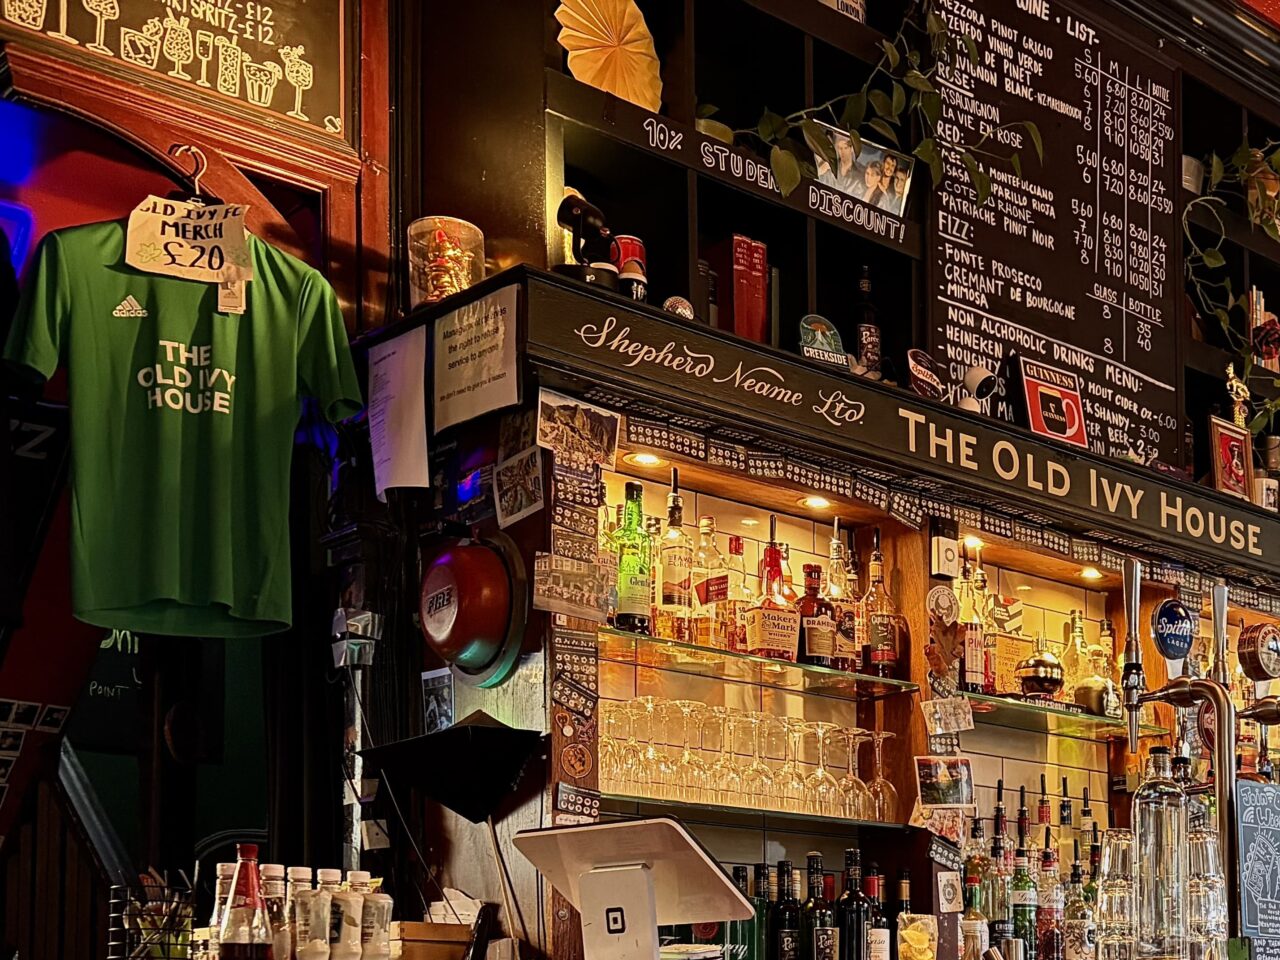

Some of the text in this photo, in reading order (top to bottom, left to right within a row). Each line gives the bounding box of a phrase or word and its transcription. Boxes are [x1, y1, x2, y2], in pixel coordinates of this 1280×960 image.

[1016, 0, 1050, 21] WINE
[991, 19, 1019, 43] PINOT
[1022, 36, 1053, 60] GRIGIO
[985, 51, 1032, 86] DE PINET
[987, 34, 1014, 59] VINHO
[1018, 51, 1043, 77] VERDE
[1084, 48, 1170, 103] S M L BOTTLE
[1083, 85, 1091, 98] 6
[1153, 103, 1167, 121] 24
[937, 120, 965, 144] RED:
[942, 105, 1023, 149] LA VIE EN ROSE
[1083, 100, 1092, 115] 7
[1152, 136, 1164, 155] 29
[1083, 116, 1092, 131] 8
[1152, 152, 1164, 167] 31
[644, 118, 906, 244] 10% STUDEN DISCOUNT!
[1083, 167, 1091, 183] 6
[1152, 180, 1166, 194] 24
[942, 161, 1056, 220] ISASA RIOJA
[944, 181, 1034, 224] COTE RHONE
[180, 207, 218, 220] IVY
[223, 206, 241, 219] FC
[938, 210, 974, 240] FIZZ:
[942, 192, 1055, 251] PATRIACHE PINOT NOIR
[160, 219, 224, 240] MERCH
[163, 241, 225, 271] £20
[1078, 218, 1166, 269] 7 29
[1152, 235, 1167, 252] 24
[945, 242, 1042, 291] FONTE PROSECCO
[1080, 249, 1162, 298] 8 31
[1153, 265, 1166, 281] 30
[944, 263, 1076, 320] CREMANT DE BOURGOGNE
[947, 282, 989, 309] MIMOSA
[1093, 283, 1162, 322] GLASS BOTTLE
[112, 309, 148, 318] adidas
[1102, 304, 1152, 339] 8 35
[159, 340, 211, 366] THE
[946, 324, 1003, 359] HEINEKEN
[948, 306, 1143, 393] NON ALCHOHOLIC DRINKS MENU:
[1103, 338, 1114, 354] 8
[1137, 334, 1152, 352] 40
[574, 317, 715, 378] Shepherd
[712, 361, 802, 405] Neame
[803, 346, 848, 366] CREEKSIDE
[946, 343, 1001, 375] NOUGHTY
[137, 364, 236, 392] OLD IVY
[1026, 364, 1075, 389] GUINNESS
[147, 387, 231, 414] HOUSE
[1115, 394, 1138, 415] CIDER
[1140, 425, 1160, 443] 3.00
[899, 409, 1263, 556] THE OLD IVY HOUSE
[427, 588, 451, 615] FIRE
[761, 612, 797, 624] Maker's
[771, 622, 797, 632] Mark
[1167, 638, 1188, 649] LAGER
[1241, 787, 1267, 806] Join
